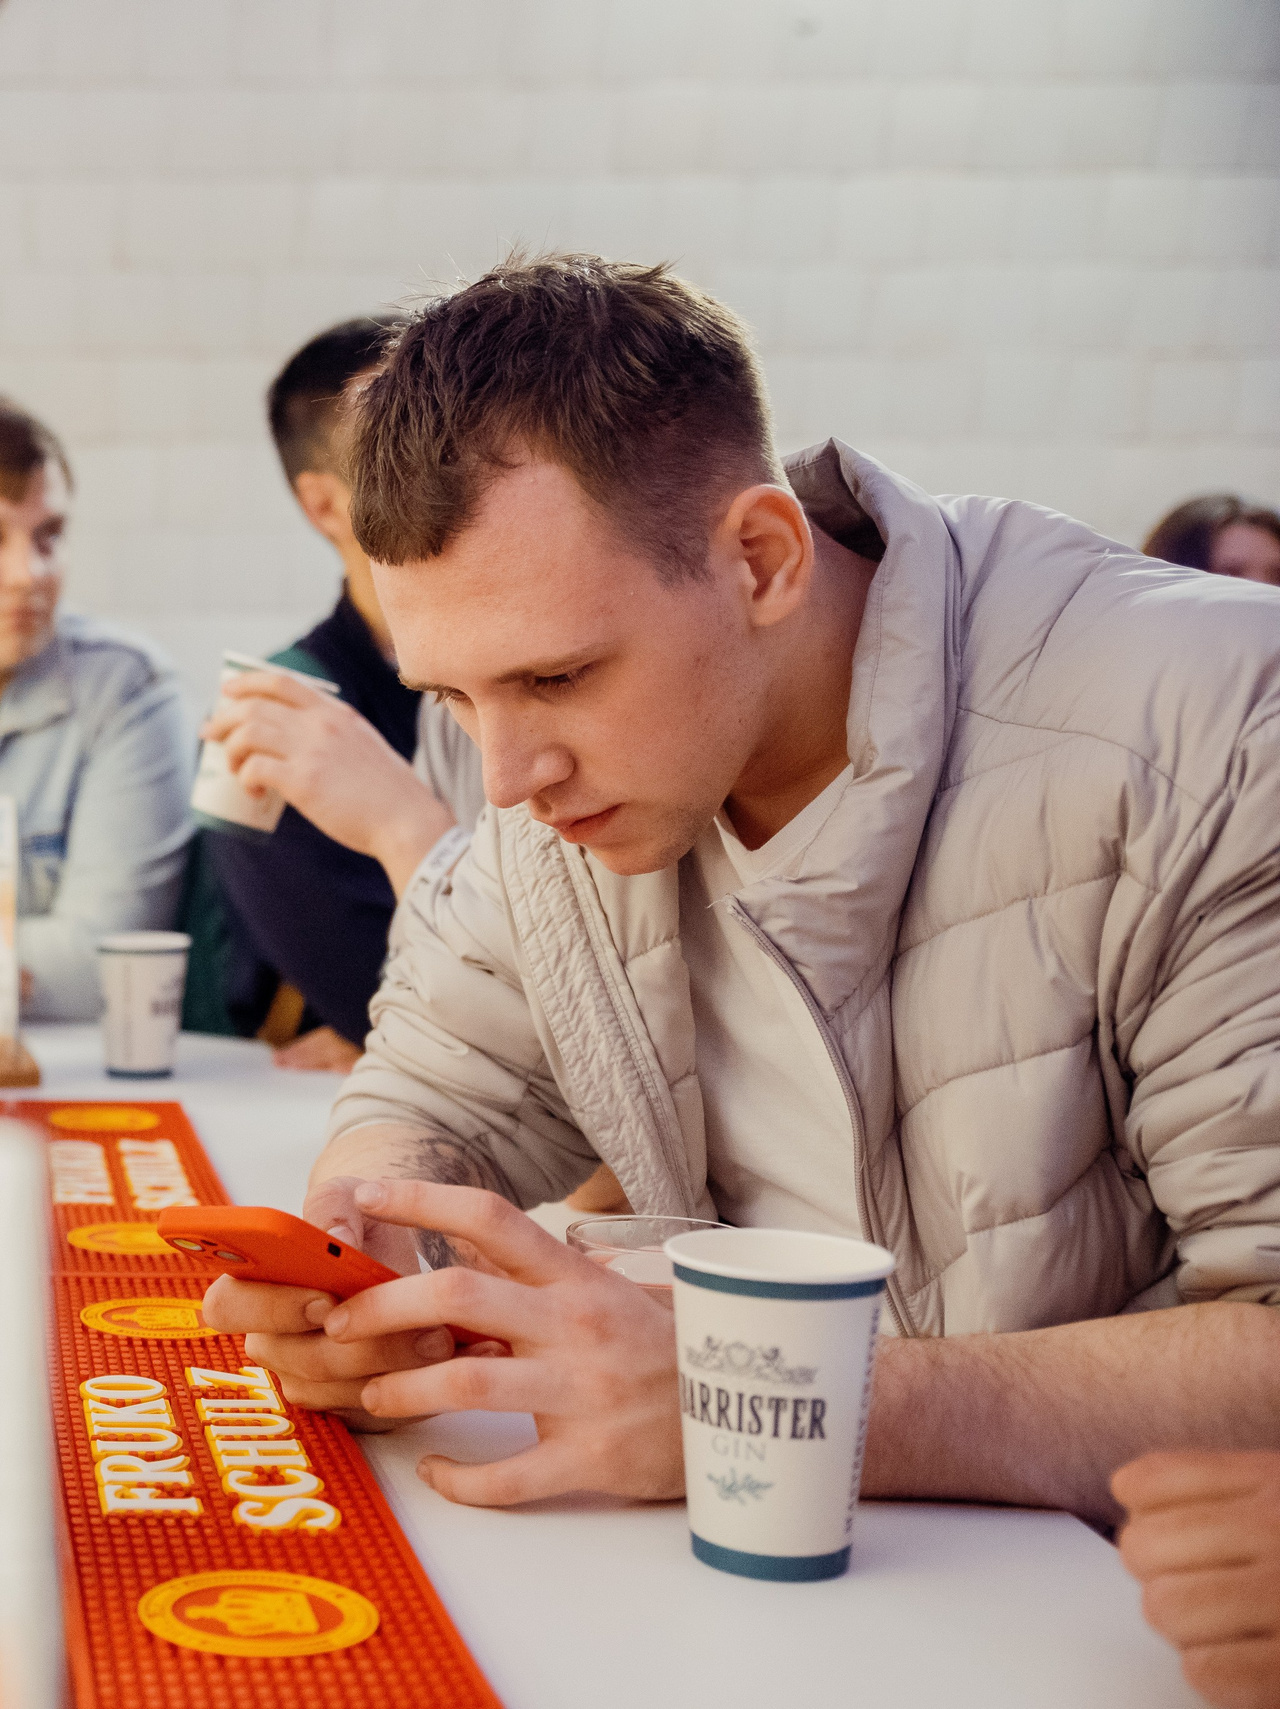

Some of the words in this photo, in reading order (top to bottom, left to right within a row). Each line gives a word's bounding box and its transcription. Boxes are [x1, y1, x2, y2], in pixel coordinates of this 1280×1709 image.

[80, 1374, 204, 1516] FRUKO
[184, 1365, 342, 1532] SCHULZ
[711, 1433, 766, 1462] GIN
